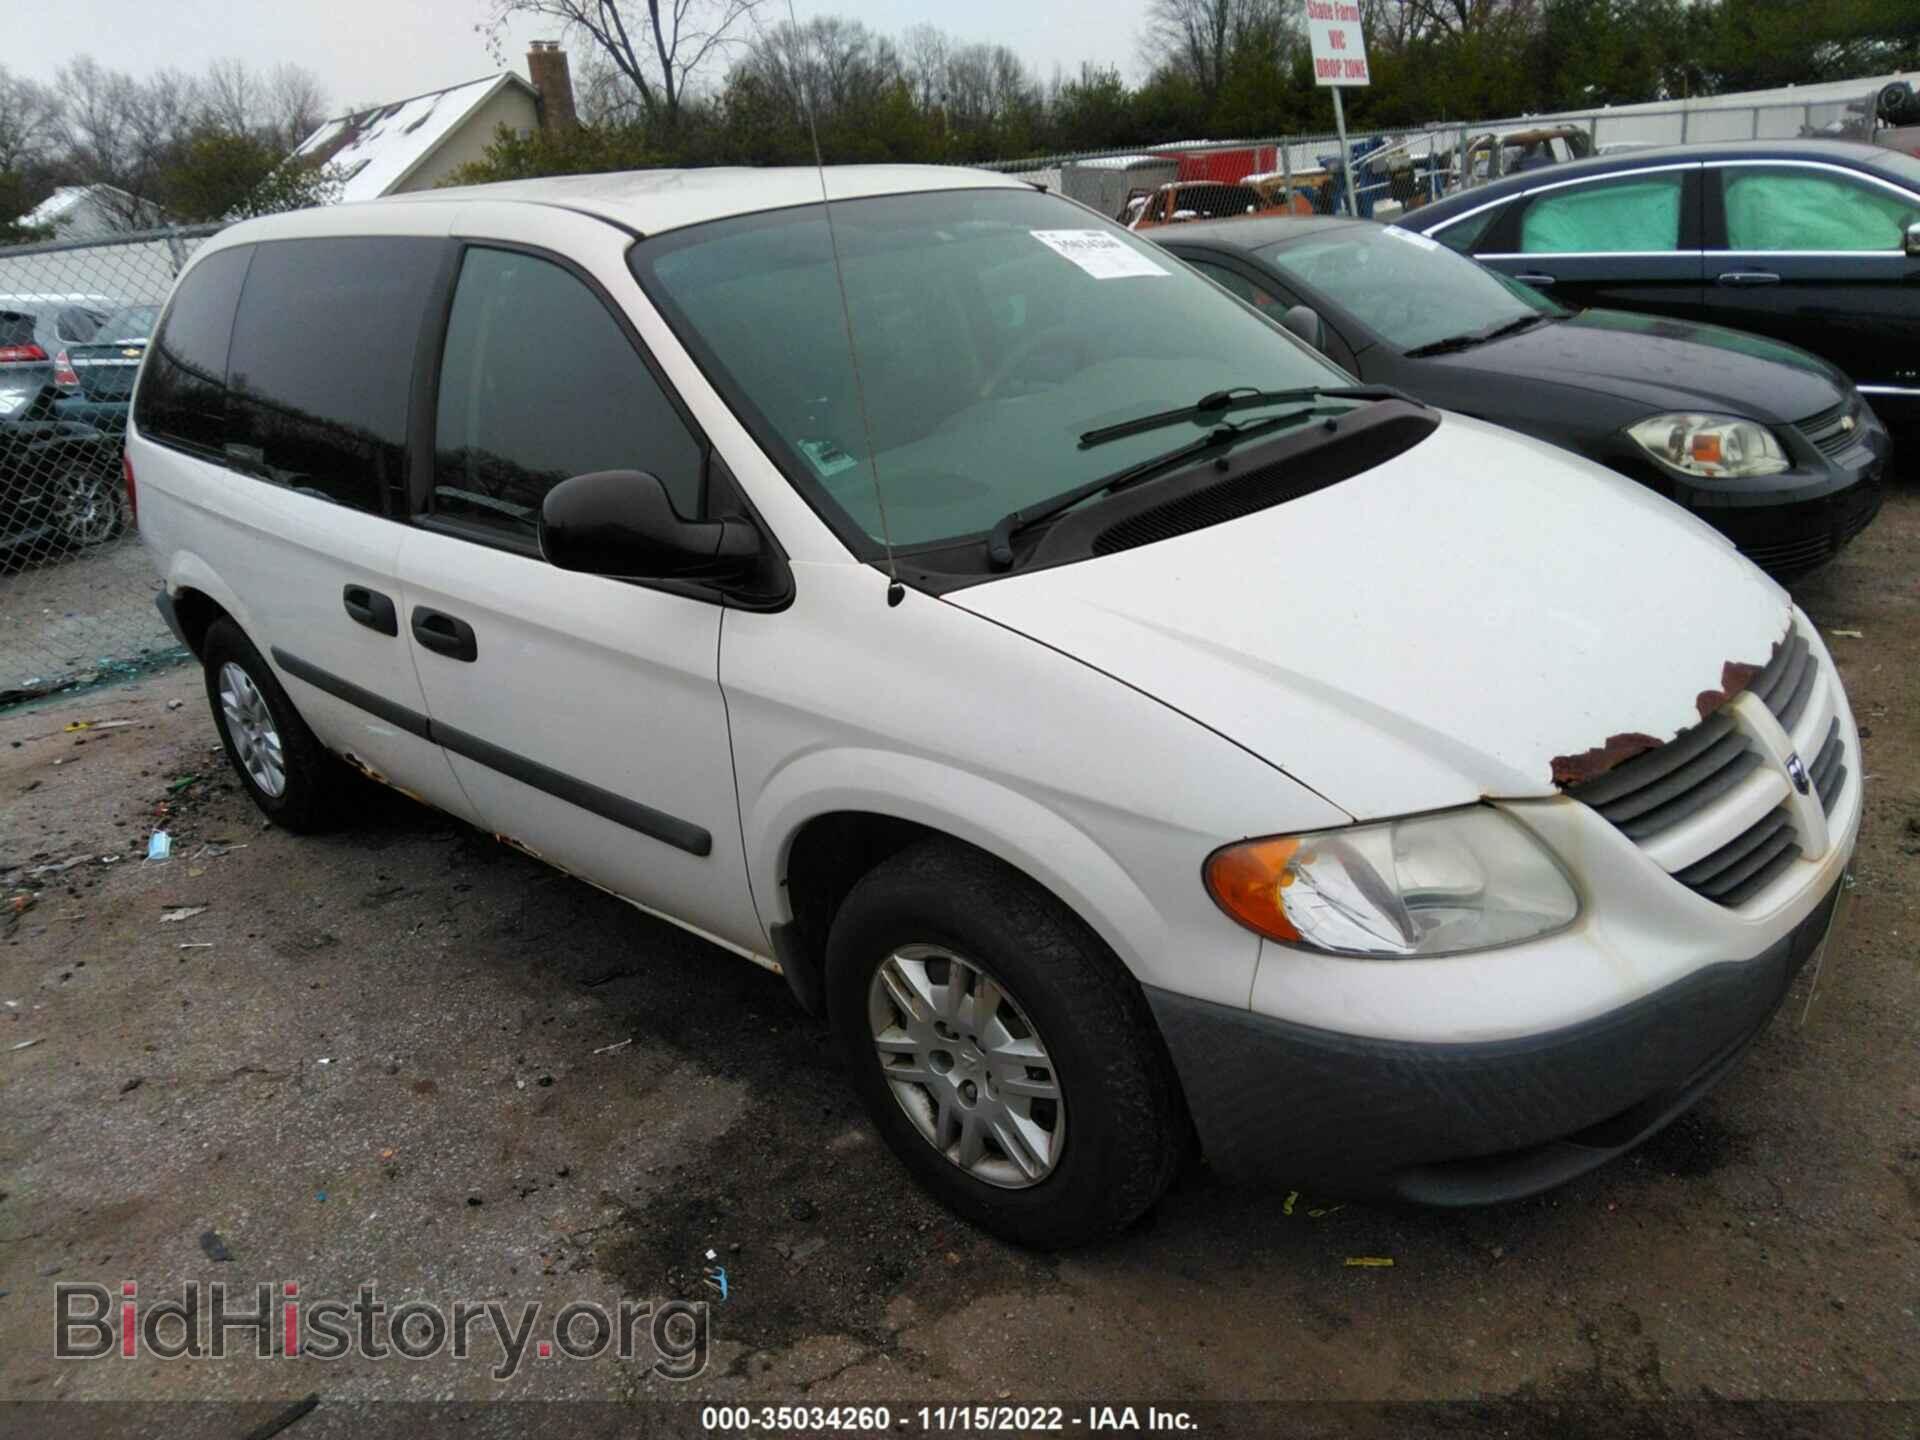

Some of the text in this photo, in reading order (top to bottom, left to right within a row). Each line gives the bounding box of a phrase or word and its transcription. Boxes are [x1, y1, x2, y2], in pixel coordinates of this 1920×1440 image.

[1307, 0, 1359, 21] State Farm
[1328, 30, 1346, 50] VIC
[1316, 59, 1366, 79] DROP ZONE
